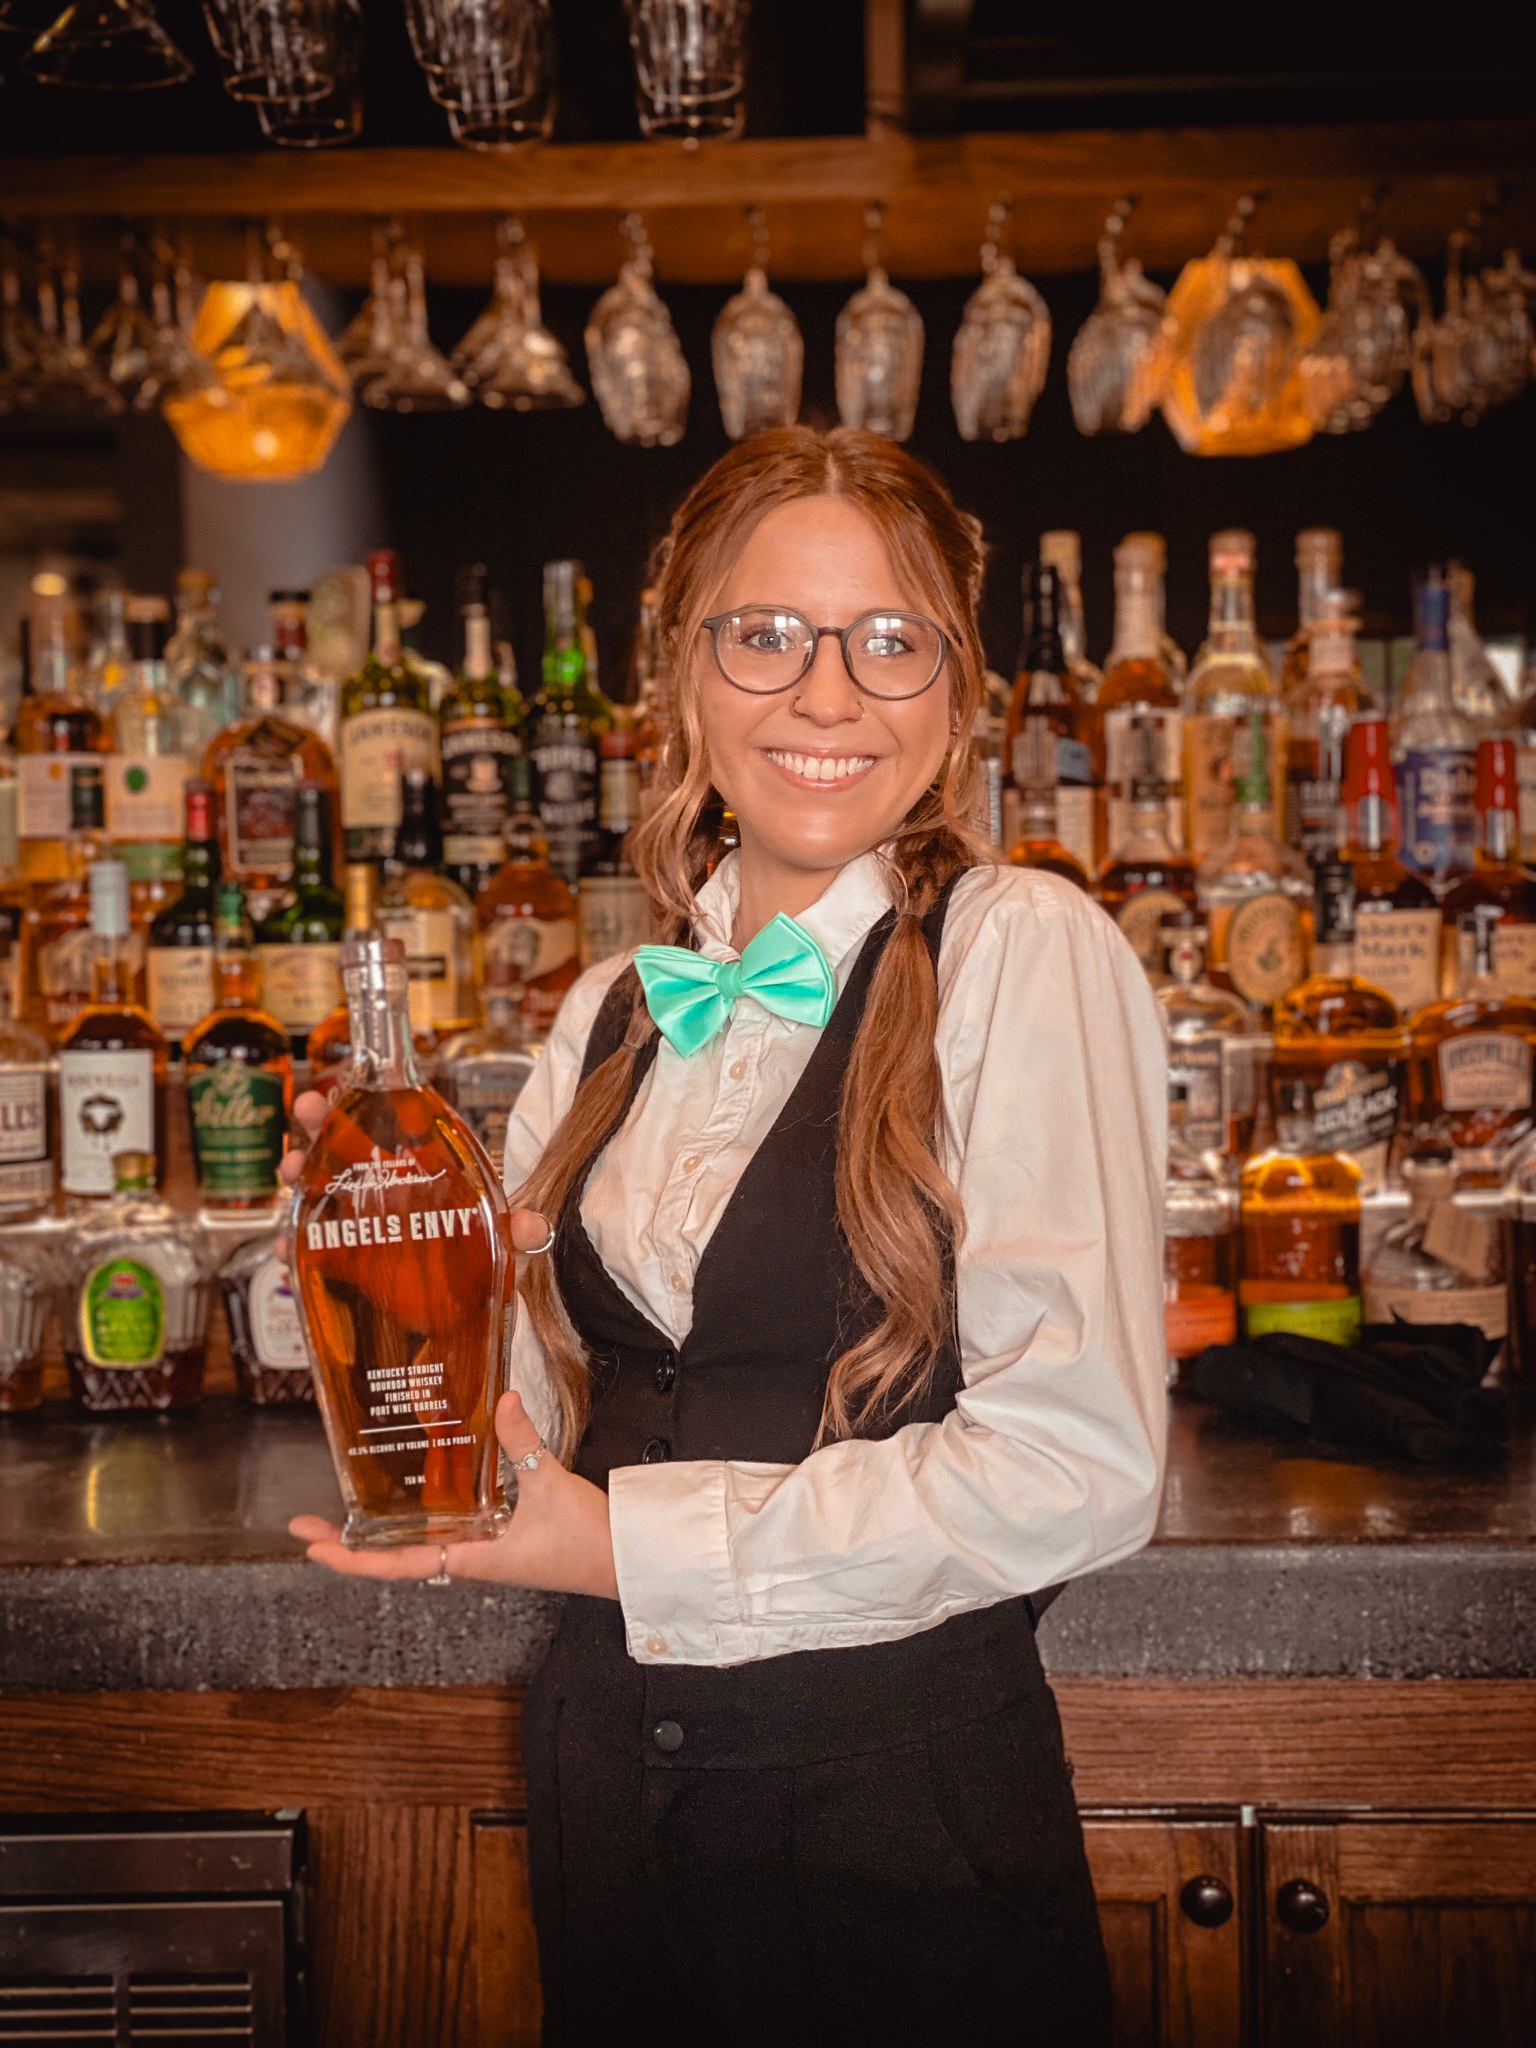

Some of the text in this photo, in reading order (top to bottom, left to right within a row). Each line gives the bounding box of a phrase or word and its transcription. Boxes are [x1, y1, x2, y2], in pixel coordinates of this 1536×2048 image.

[383, 1159, 407, 1169] CELLARS
[366, 1363, 444, 1380] KENTUCKY STRAIGHT
[370, 1375, 443, 1392] BOURBON WHISKEY
[385, 1389, 431, 1402] FINISHED IN
[370, 1399, 448, 1417] PORT WINE BARRELS
[369, 1443, 396, 1454] ALCOHOL
[396, 1442, 405, 1451] BY
[406, 1440, 430, 1450] VOLUME
[404, 1475, 416, 1486] 750
